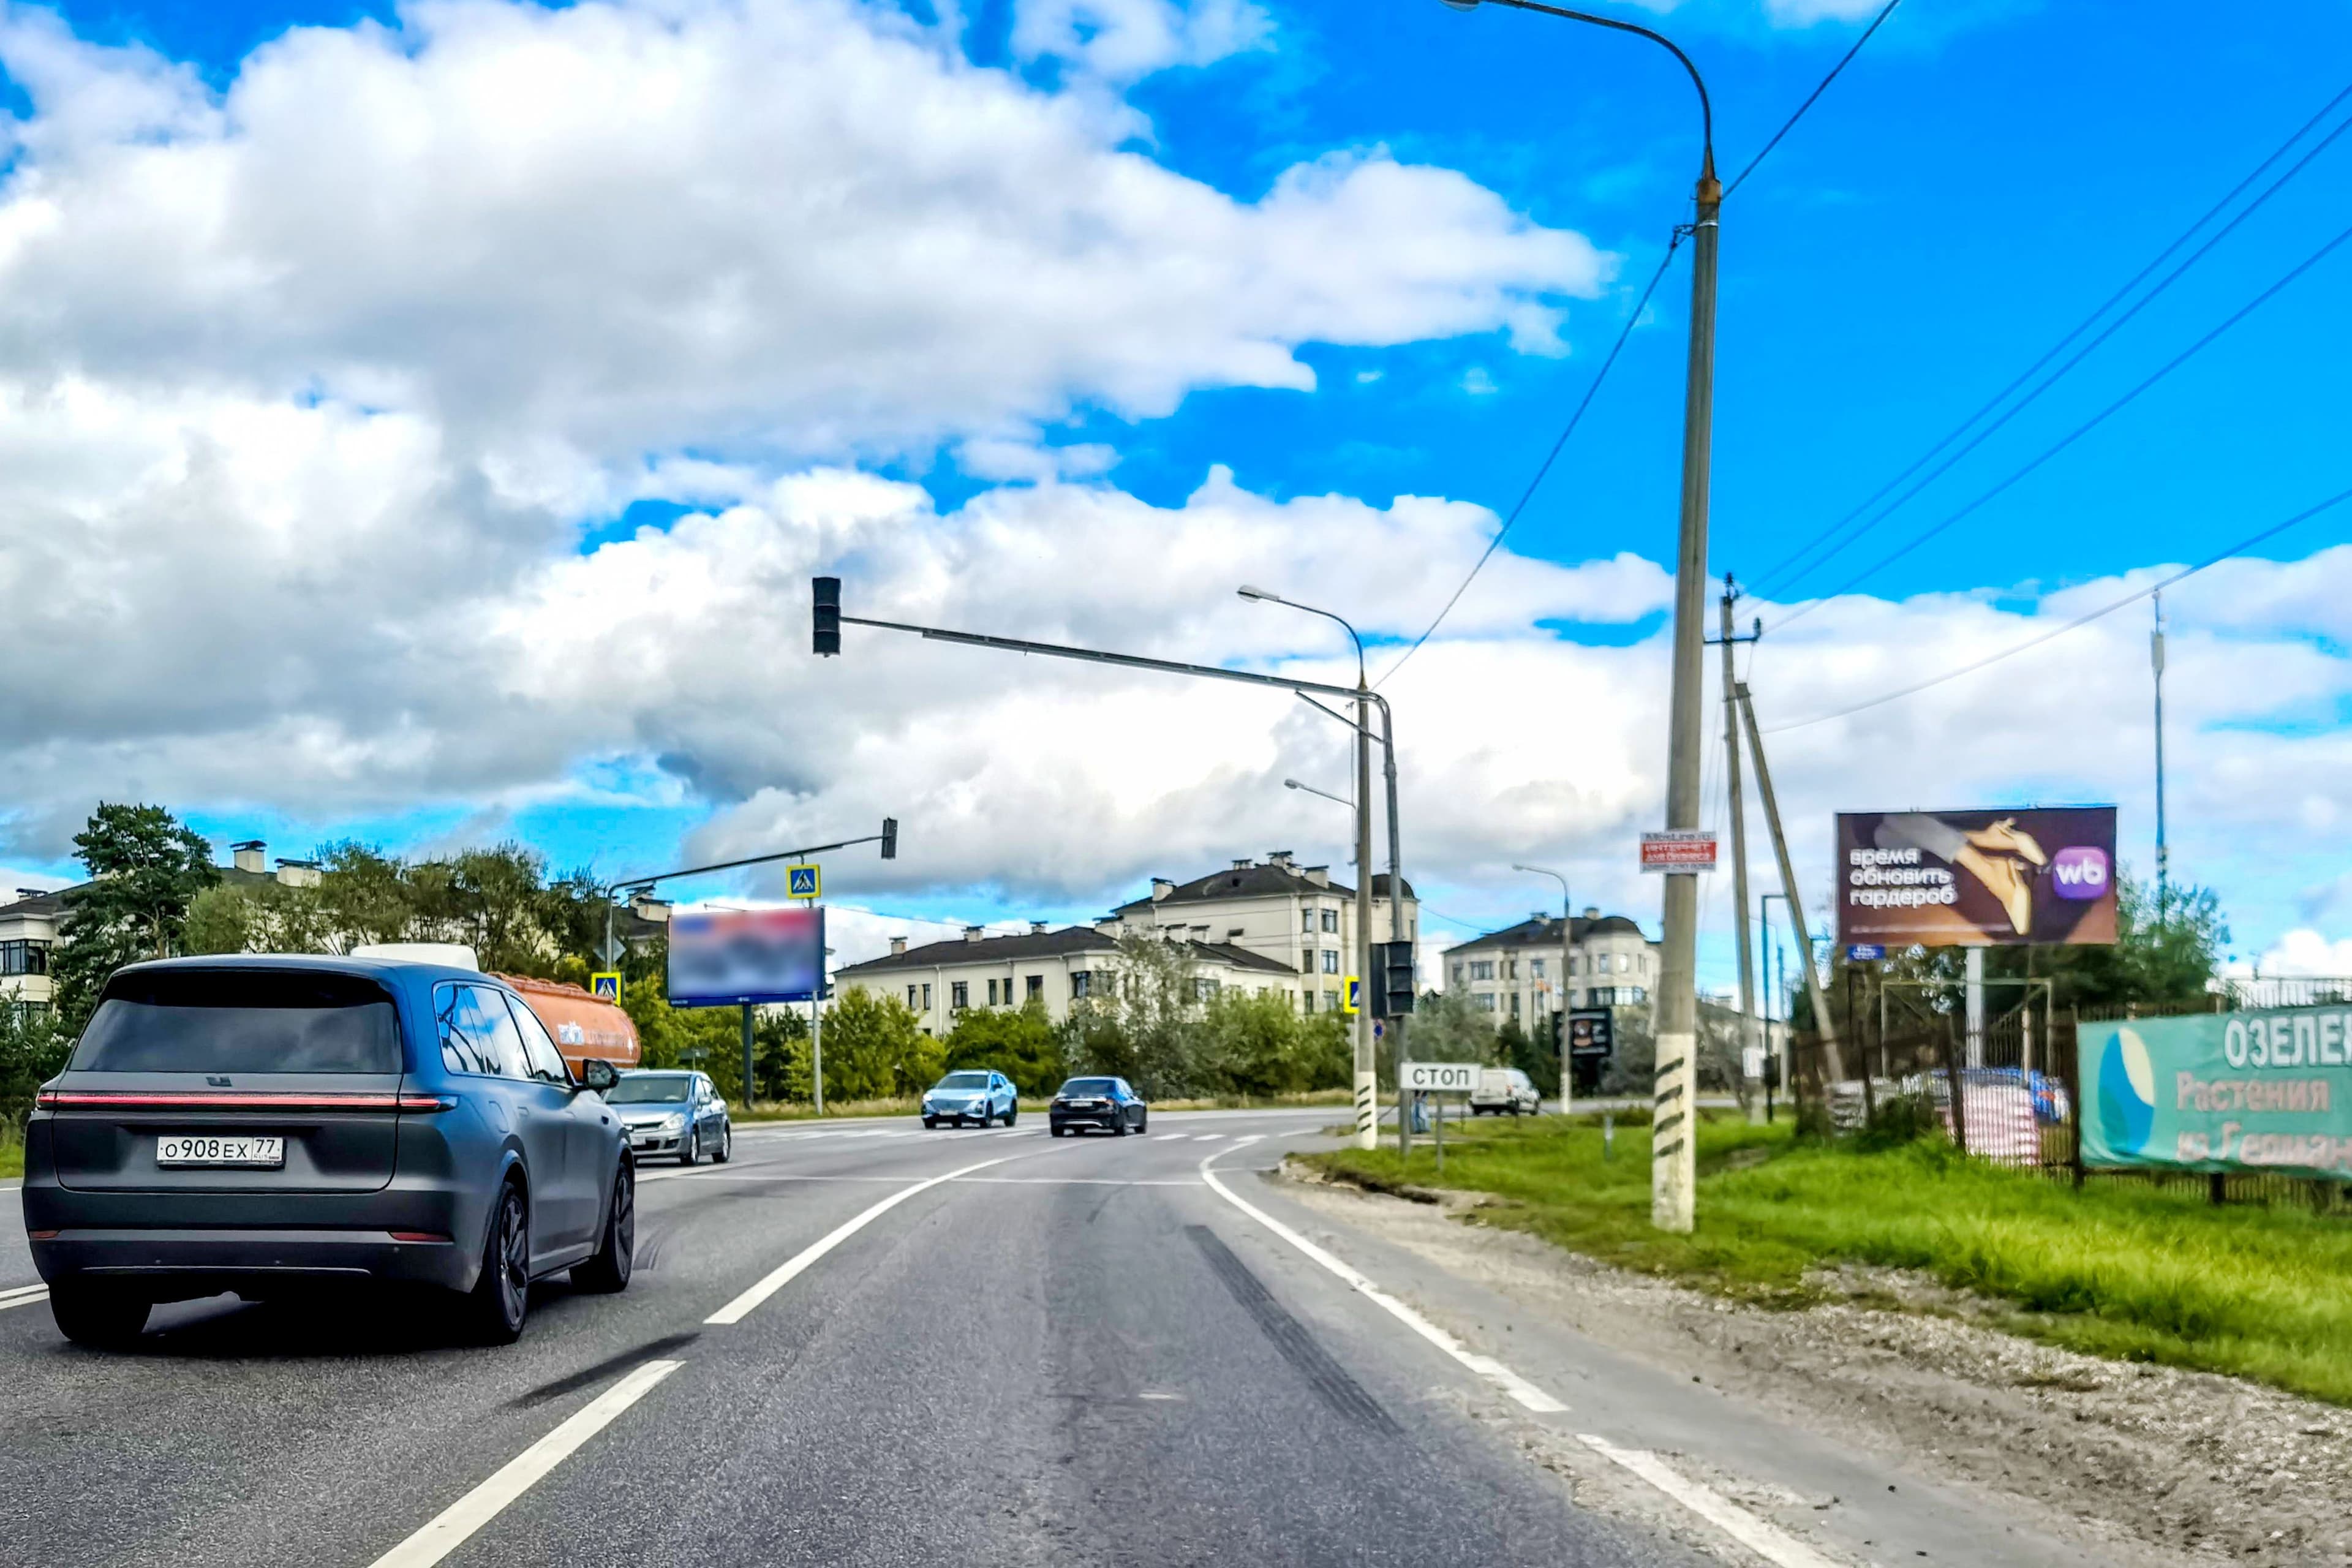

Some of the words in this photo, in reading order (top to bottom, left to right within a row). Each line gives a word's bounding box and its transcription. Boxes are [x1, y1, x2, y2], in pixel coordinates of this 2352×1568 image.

[1850, 848, 1919, 869] время
[1850, 866, 1953, 886] обновить
[2056, 858, 2106, 885] wb
[1850, 884, 1958, 909] гардероб
[1412, 1069, 1469, 1085] СТОП
[2177, 1071, 2330, 1111] Растения
